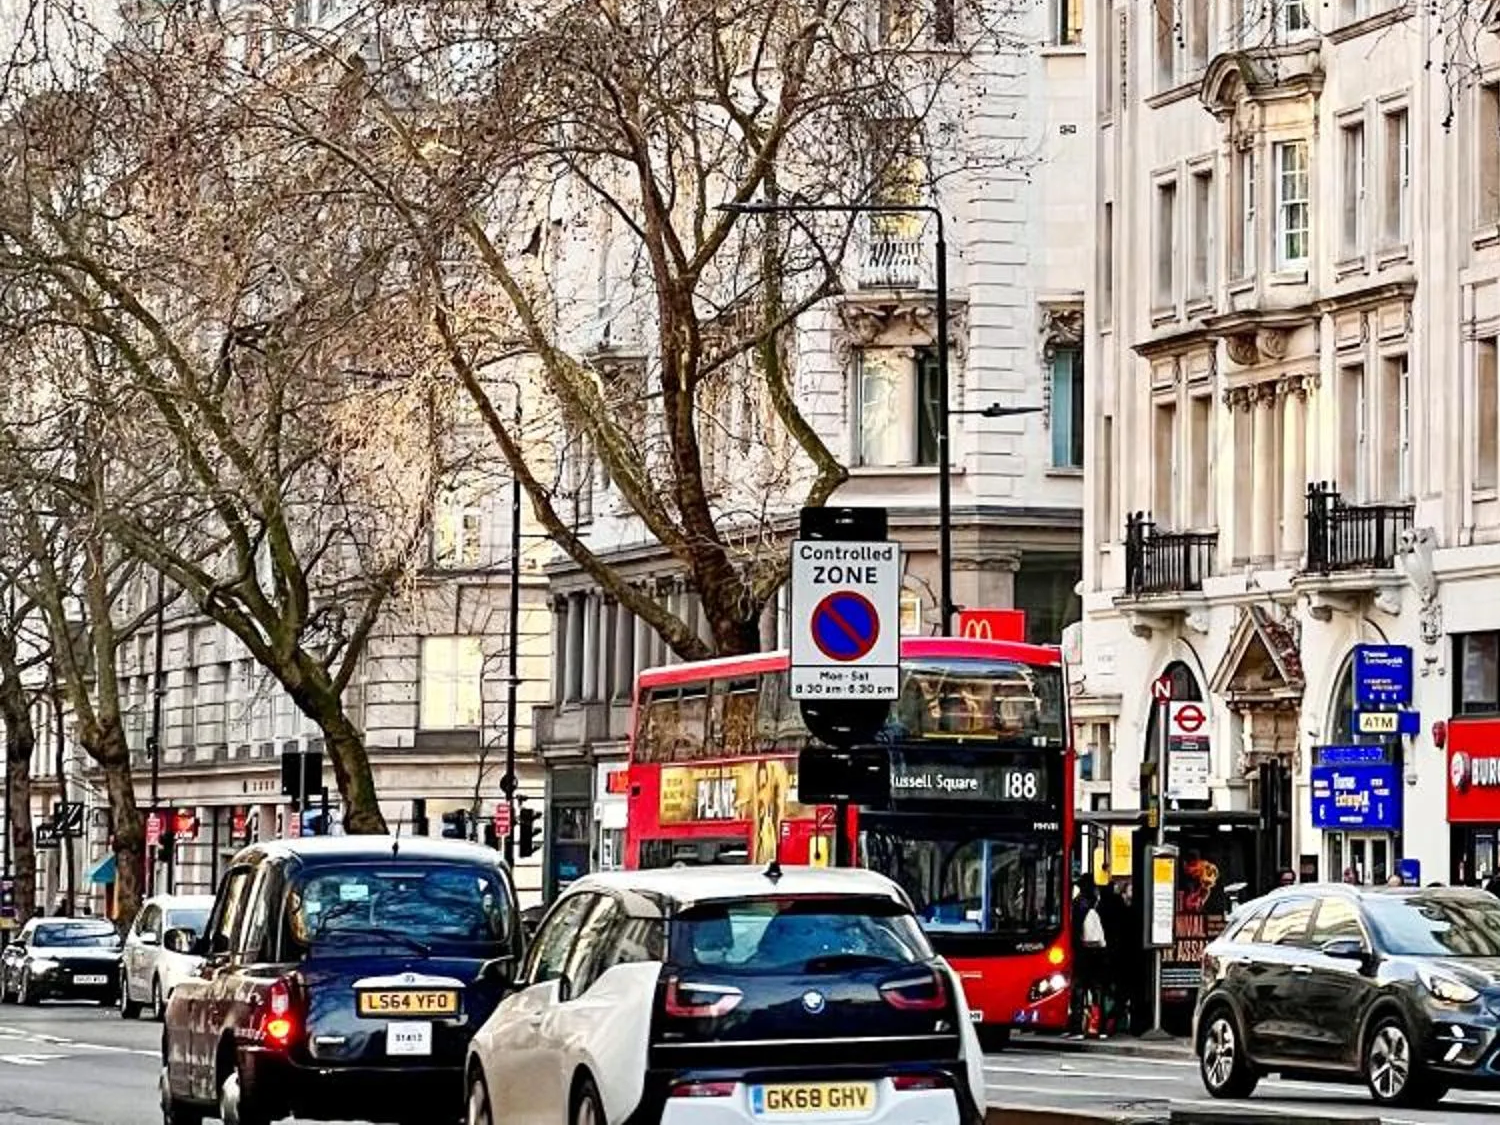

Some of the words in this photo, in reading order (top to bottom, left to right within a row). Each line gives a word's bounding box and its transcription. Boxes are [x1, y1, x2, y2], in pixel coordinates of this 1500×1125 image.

[800, 545, 893, 561] Controlled
[813, 566, 878, 584] ZONE
[820, 671, 842, 681] Mon
[851, 671, 869, 681] Sat
[877, 686, 895, 695] pm
[1155, 680, 1171, 698] N
[1365, 717, 1394, 730] ATM
[936, 774, 979, 792] Square
[1004, 772, 1037, 799] 188
[368, 994, 411, 1010] LS64
[416, 993, 448, 1009] YFO
[766, 1087, 823, 1110] GK68
[828, 1086, 868, 1108] GHV
